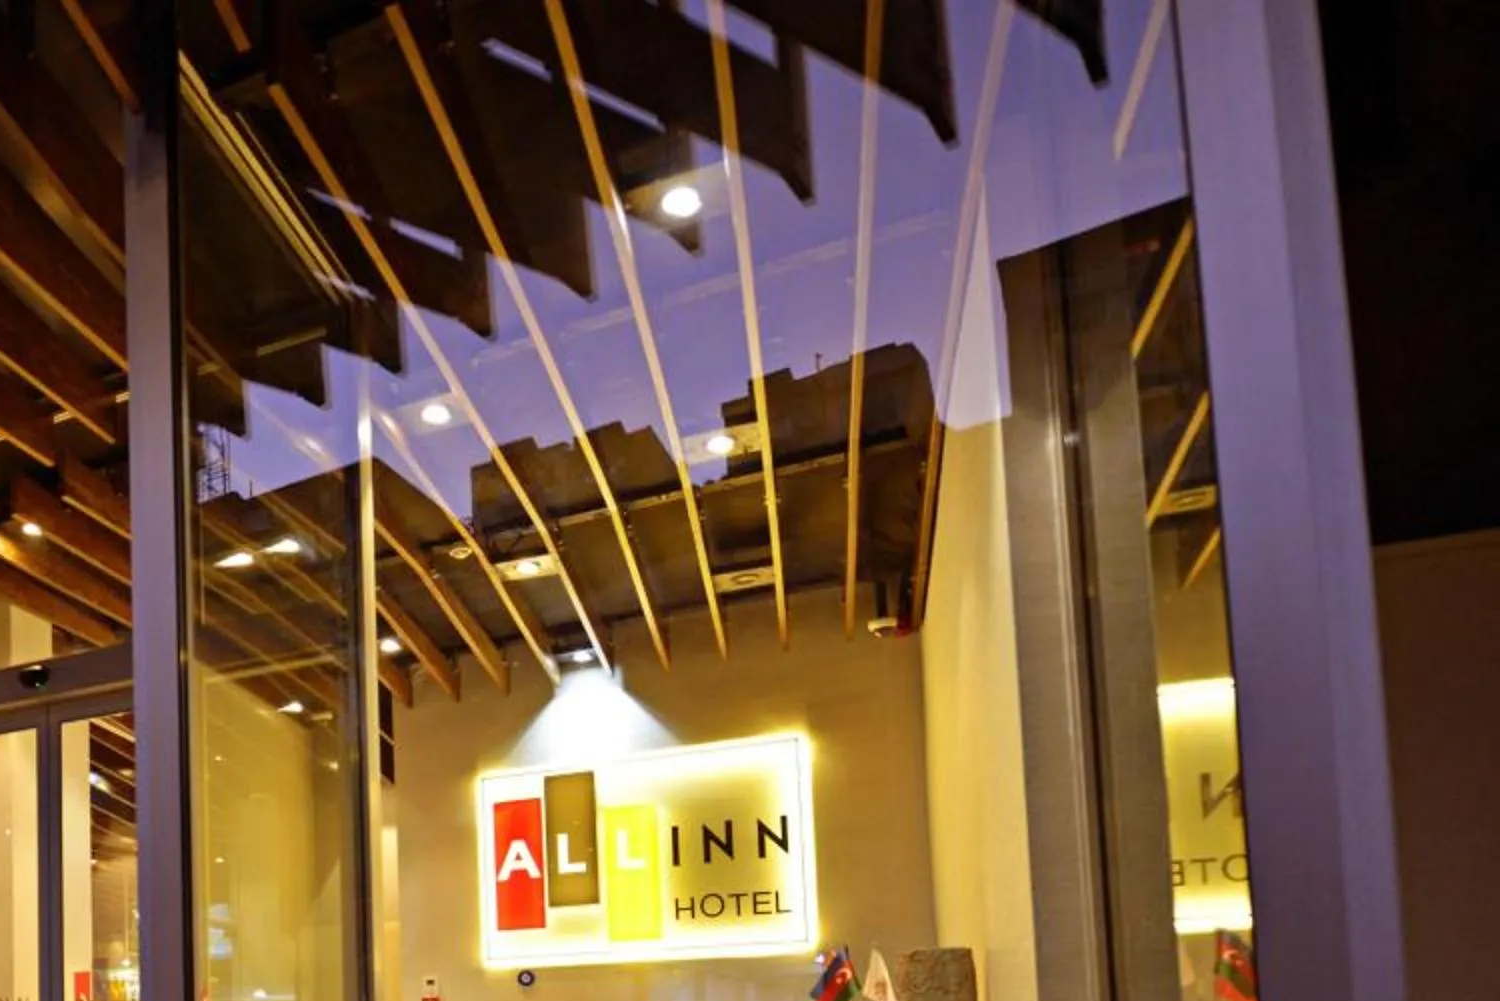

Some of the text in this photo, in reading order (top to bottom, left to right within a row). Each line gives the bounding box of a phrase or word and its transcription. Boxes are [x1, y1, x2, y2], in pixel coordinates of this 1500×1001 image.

[498, 815, 790, 880] ALL INN
[675, 890, 792, 921] HOTEL
